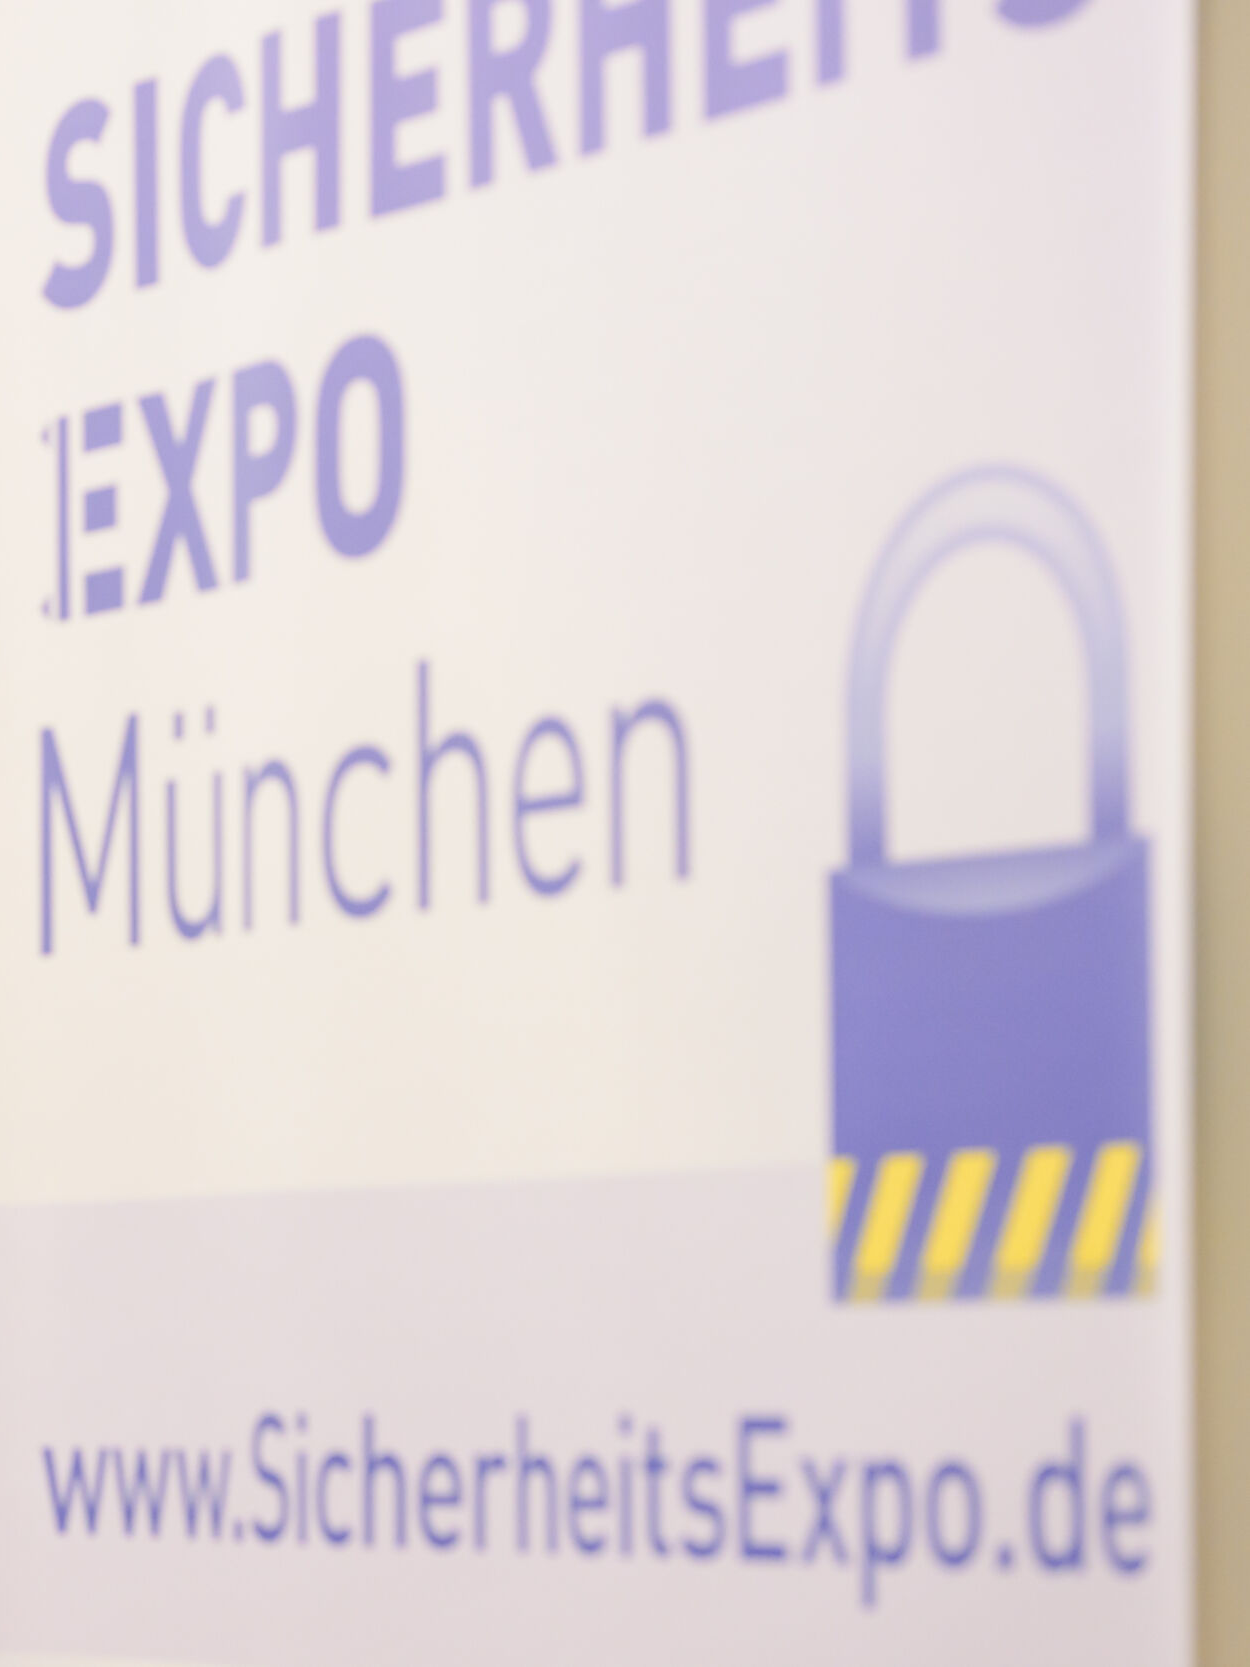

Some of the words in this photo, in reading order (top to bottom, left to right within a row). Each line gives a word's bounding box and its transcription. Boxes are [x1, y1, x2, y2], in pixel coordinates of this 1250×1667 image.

[42, 0, 1095, 309] SICHERH
[42, 332, 407, 621] EXPO
[40, 658, 690, 957] München
[42, 1412, 1152, 1607] www.SicherheitsExpo.de
